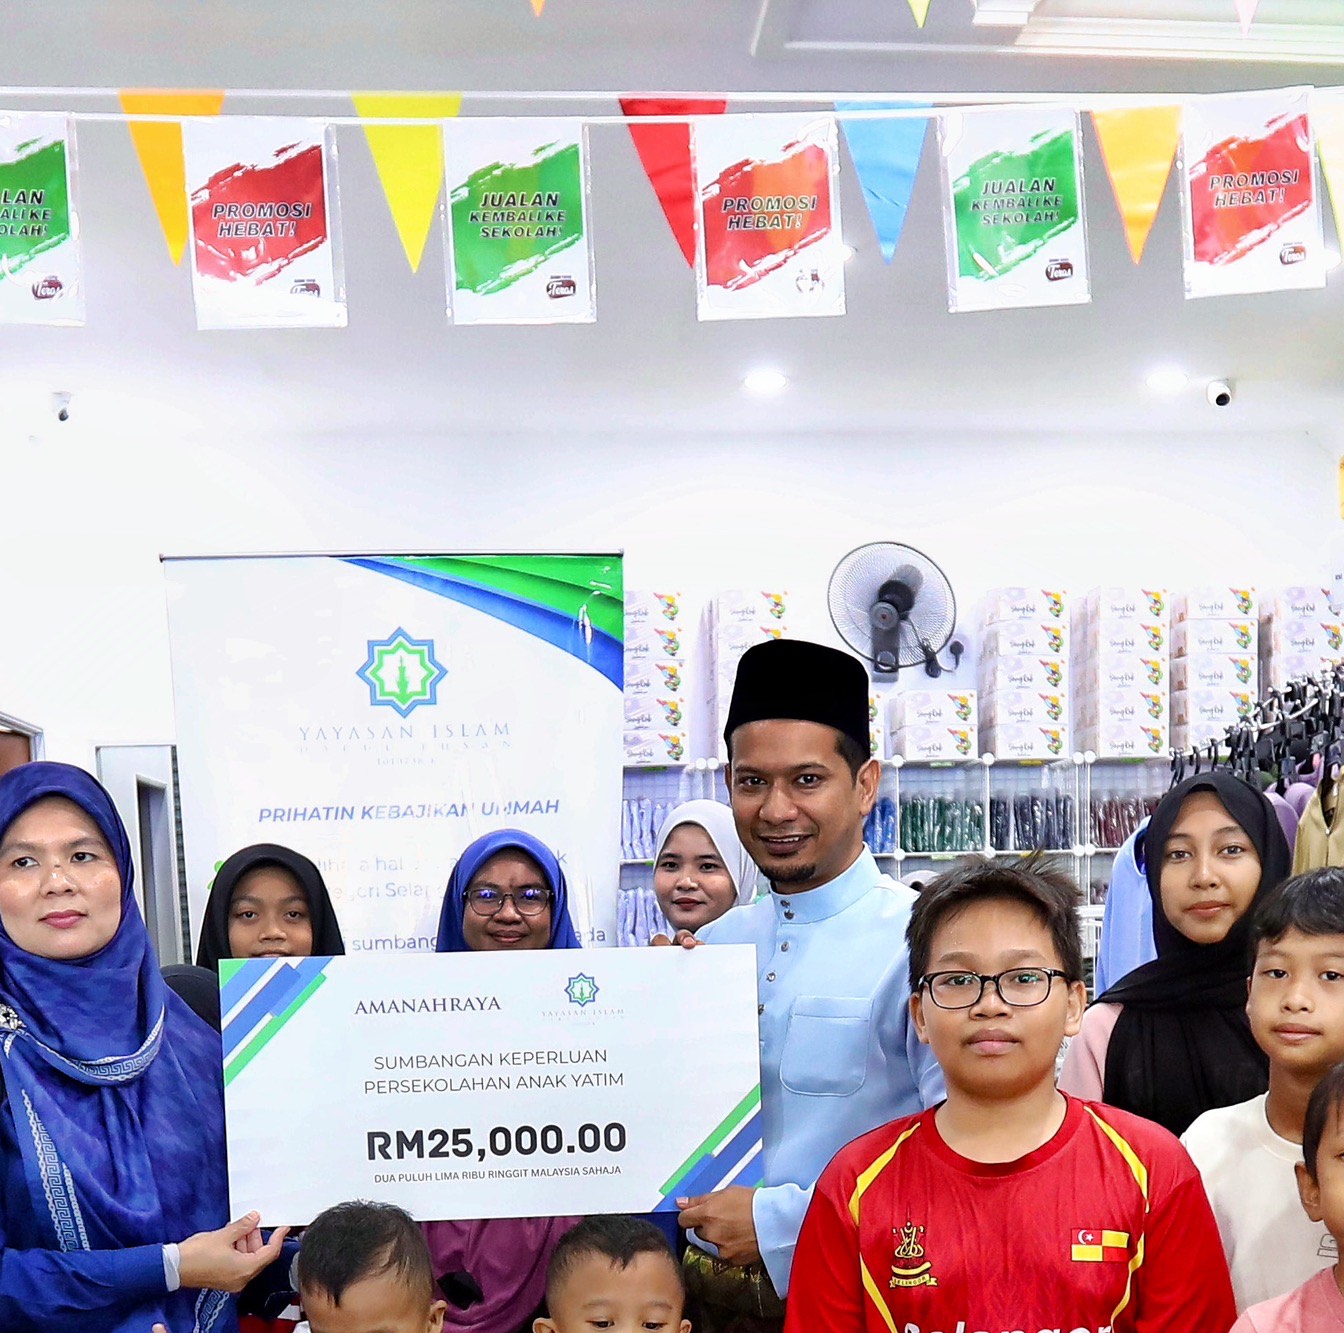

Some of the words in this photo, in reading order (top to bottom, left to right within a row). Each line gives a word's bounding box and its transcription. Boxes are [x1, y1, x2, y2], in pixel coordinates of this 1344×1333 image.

[982, 177, 1058, 195] JUALAN
[1209, 169, 1300, 190] PROMOSI
[480, 192, 560, 208] JUALAN
[723, 195, 818, 212] PROMOSI
[971, 195, 1041, 212] KEMBALI
[1043, 194, 1064, 208] KE
[1214, 187, 1287, 208] HEBAT!
[29, 208, 52, 220] KE
[212, 201, 312, 220] PROMOSI
[470, 210, 542, 224] KEMBALI
[545, 209, 567, 223] KE
[218, 220, 298, 238] HEBAT!
[728, 214, 804, 231] HEBAT!
[480, 226, 562, 239] SEKOLAH!
[299, 725, 413, 741] YAYASAN
[433, 723, 509, 738] ISLAM
[258, 805, 355, 823] PRIHATIN
[361, 803, 474, 820] KEBAJIKAN
[354, 996, 503, 1016] AMANAHRAYA
[374, 1052, 493, 1071] SUMBANGAN
[500, 1049, 608, 1066] KEPERLUAN
[364, 1076, 511, 1094] PERSEKOLAHAN
[516, 1074, 567, 1089] ANAK
[571, 1072, 624, 1087] YATIM
[367, 1121, 627, 1161] RM25,000.00
[374, 1173, 396, 1184] DUA
[398, 1172, 433, 1183] PULUH
[435, 1171, 460, 1181] LIMA
[462, 1170, 485, 1180] RIBU
[488, 1169, 529, 1179] RINGGIT
[531, 1167, 579, 1178] MALAYSIA
[582, 1165, 622, 1176] SAHAJA
